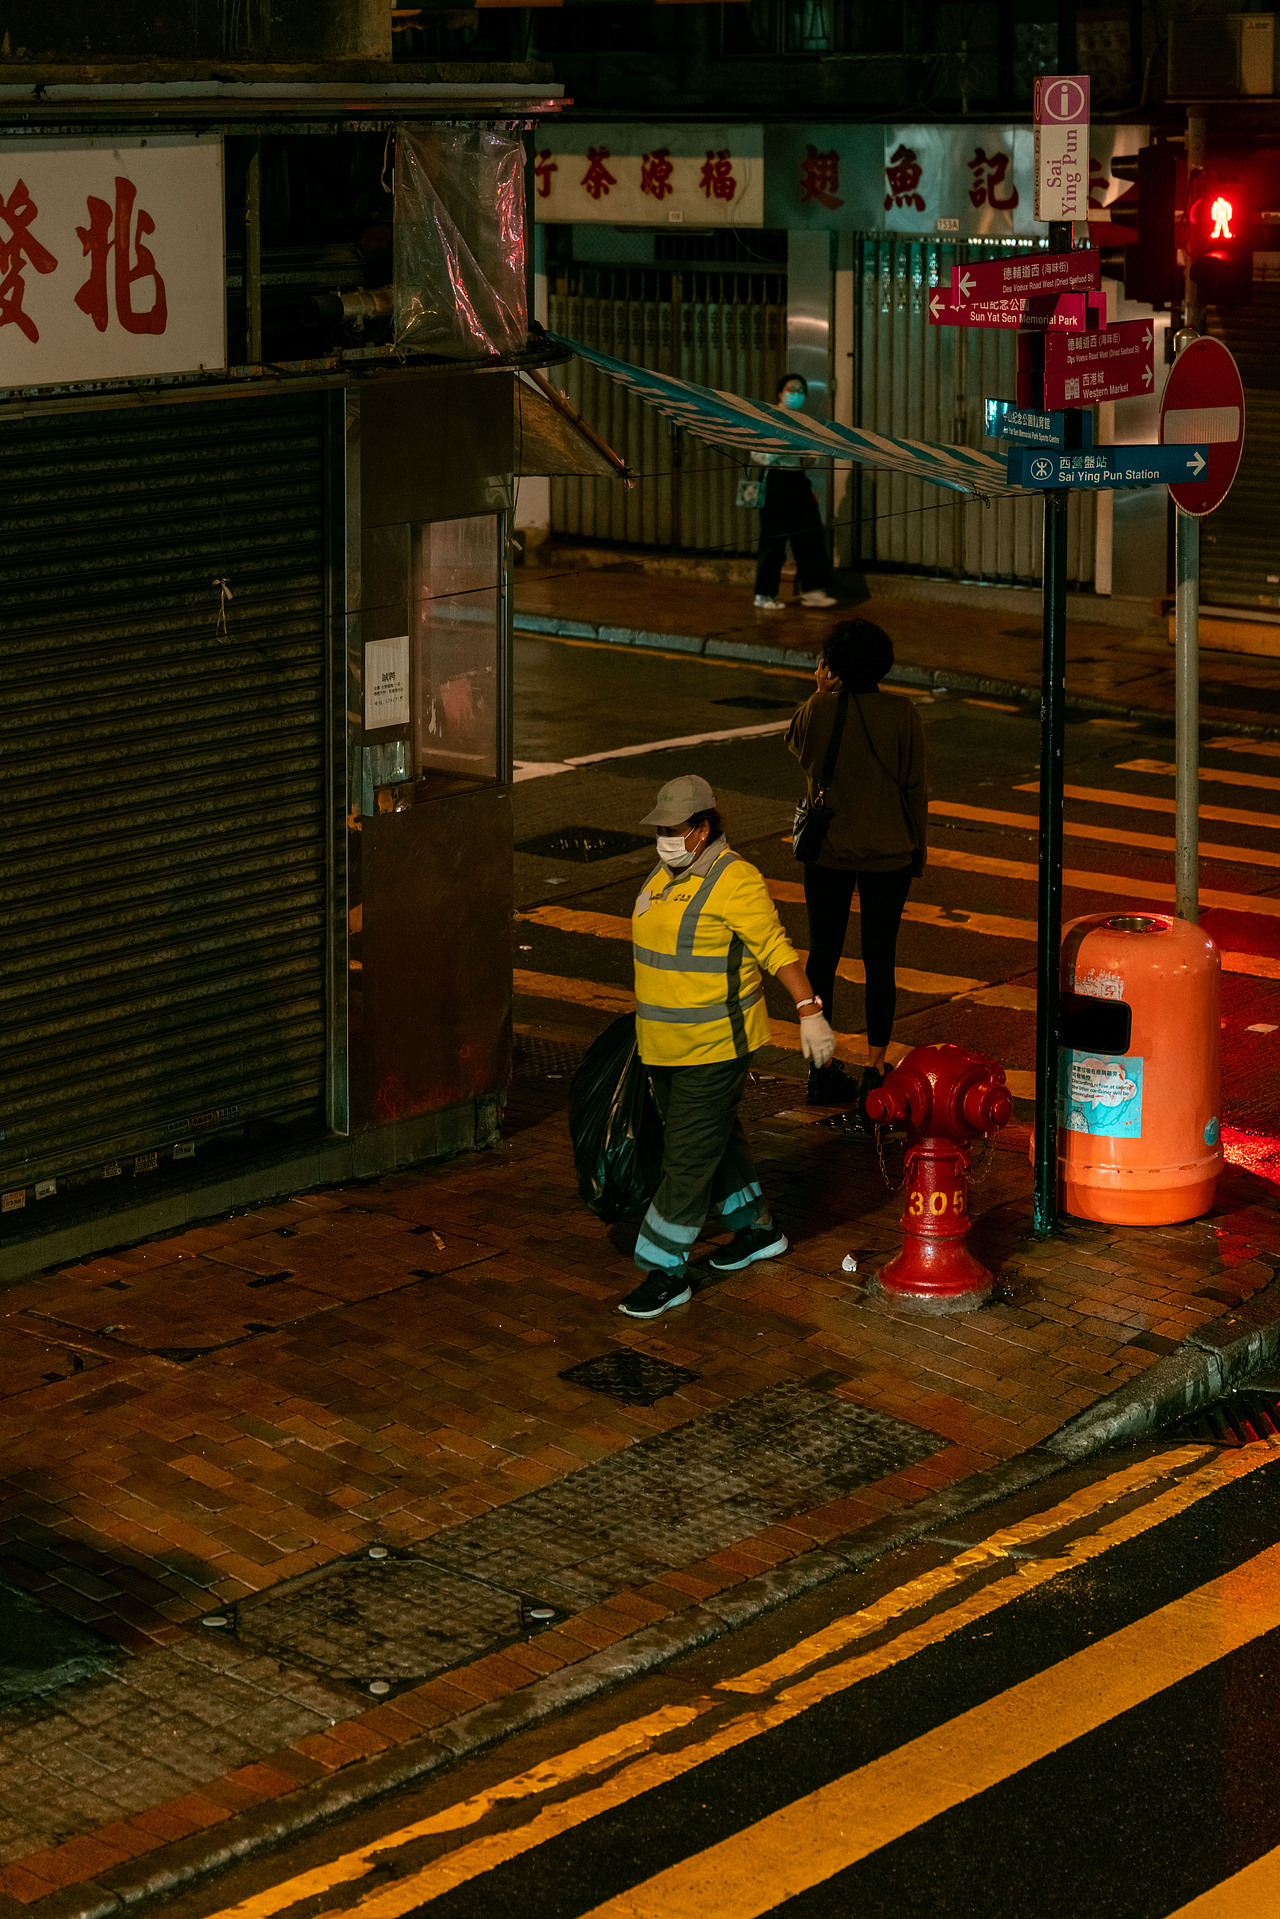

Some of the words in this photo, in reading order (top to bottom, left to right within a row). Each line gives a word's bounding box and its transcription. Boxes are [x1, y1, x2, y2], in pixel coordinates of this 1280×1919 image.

[1062, 129, 1077, 165] Pun
[1046, 159, 1062, 188] Sai
[1061, 172, 1082, 217] Ying
[1003, 263, 1040, 280] 德輔道西
[1002, 285, 1012, 293] Des
[1013, 283, 1028, 292] Voeux
[1029, 281, 1041, 290] Road
[1042, 280, 1054, 288] West
[1054, 277, 1068, 288] (Dried
[970, 311, 985, 322] Sun
[987, 312, 1000, 322] Yat
[1001, 313, 1017, 323] Sen
[1019, 313, 1056, 325] Memorial
[1058, 315, 1078, 326] Park
[1082, 370, 1104, 386] 西港城
[1082, 388, 1109, 400] Western
[1109, 382, 1129, 395] Market
[1059, 455, 1107, 469] 西營盤站
[1058, 471, 1075, 482] Sai
[1078, 471, 1100, 483] Ying
[1103, 470, 1123, 480] Pun
[1125, 469, 1160, 480] Station
[909, 1190, 964, 1216] 305
